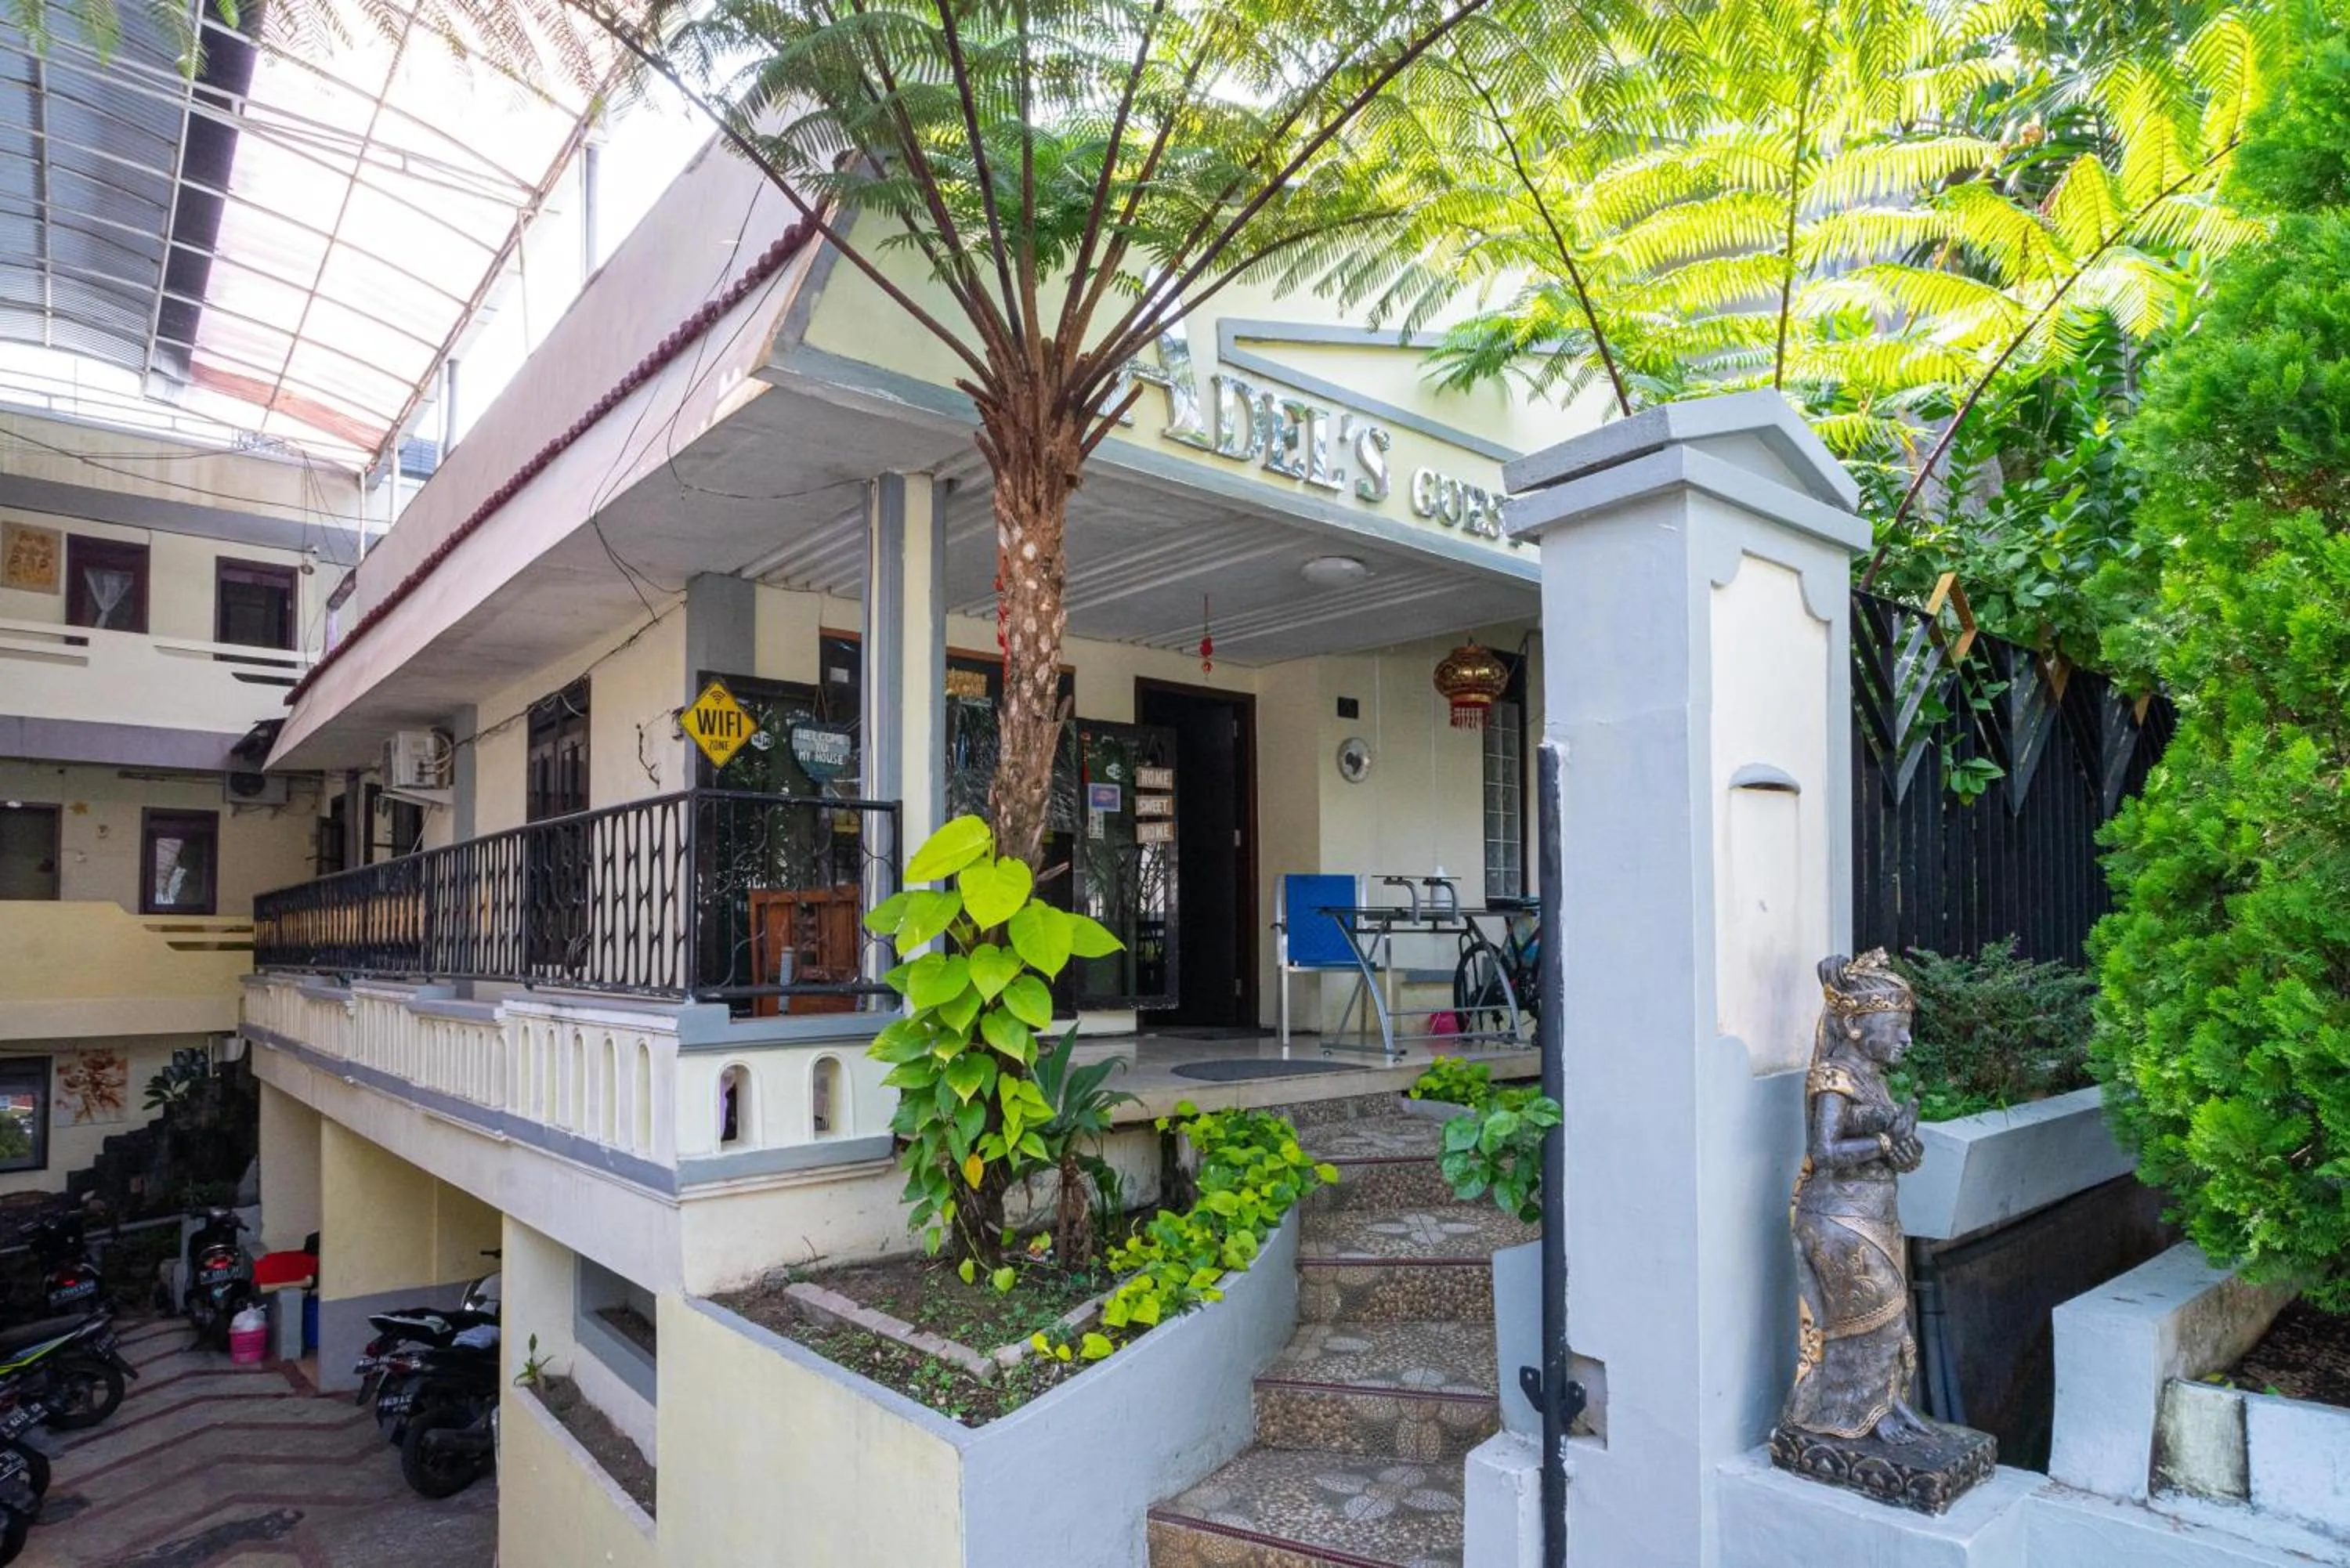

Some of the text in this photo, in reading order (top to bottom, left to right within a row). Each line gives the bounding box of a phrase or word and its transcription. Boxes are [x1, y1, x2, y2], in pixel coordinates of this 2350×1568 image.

[1411, 468, 1523, 548] GUES
[696, 707, 742, 738] WIFI
[708, 739, 730, 751] ZONE
[798, 750, 844, 765] MY HOUSE
[1141, 769, 1170, 787] HOME
[1139, 799, 1168, 813] SWEET
[1141, 823, 1170, 839] HOME
